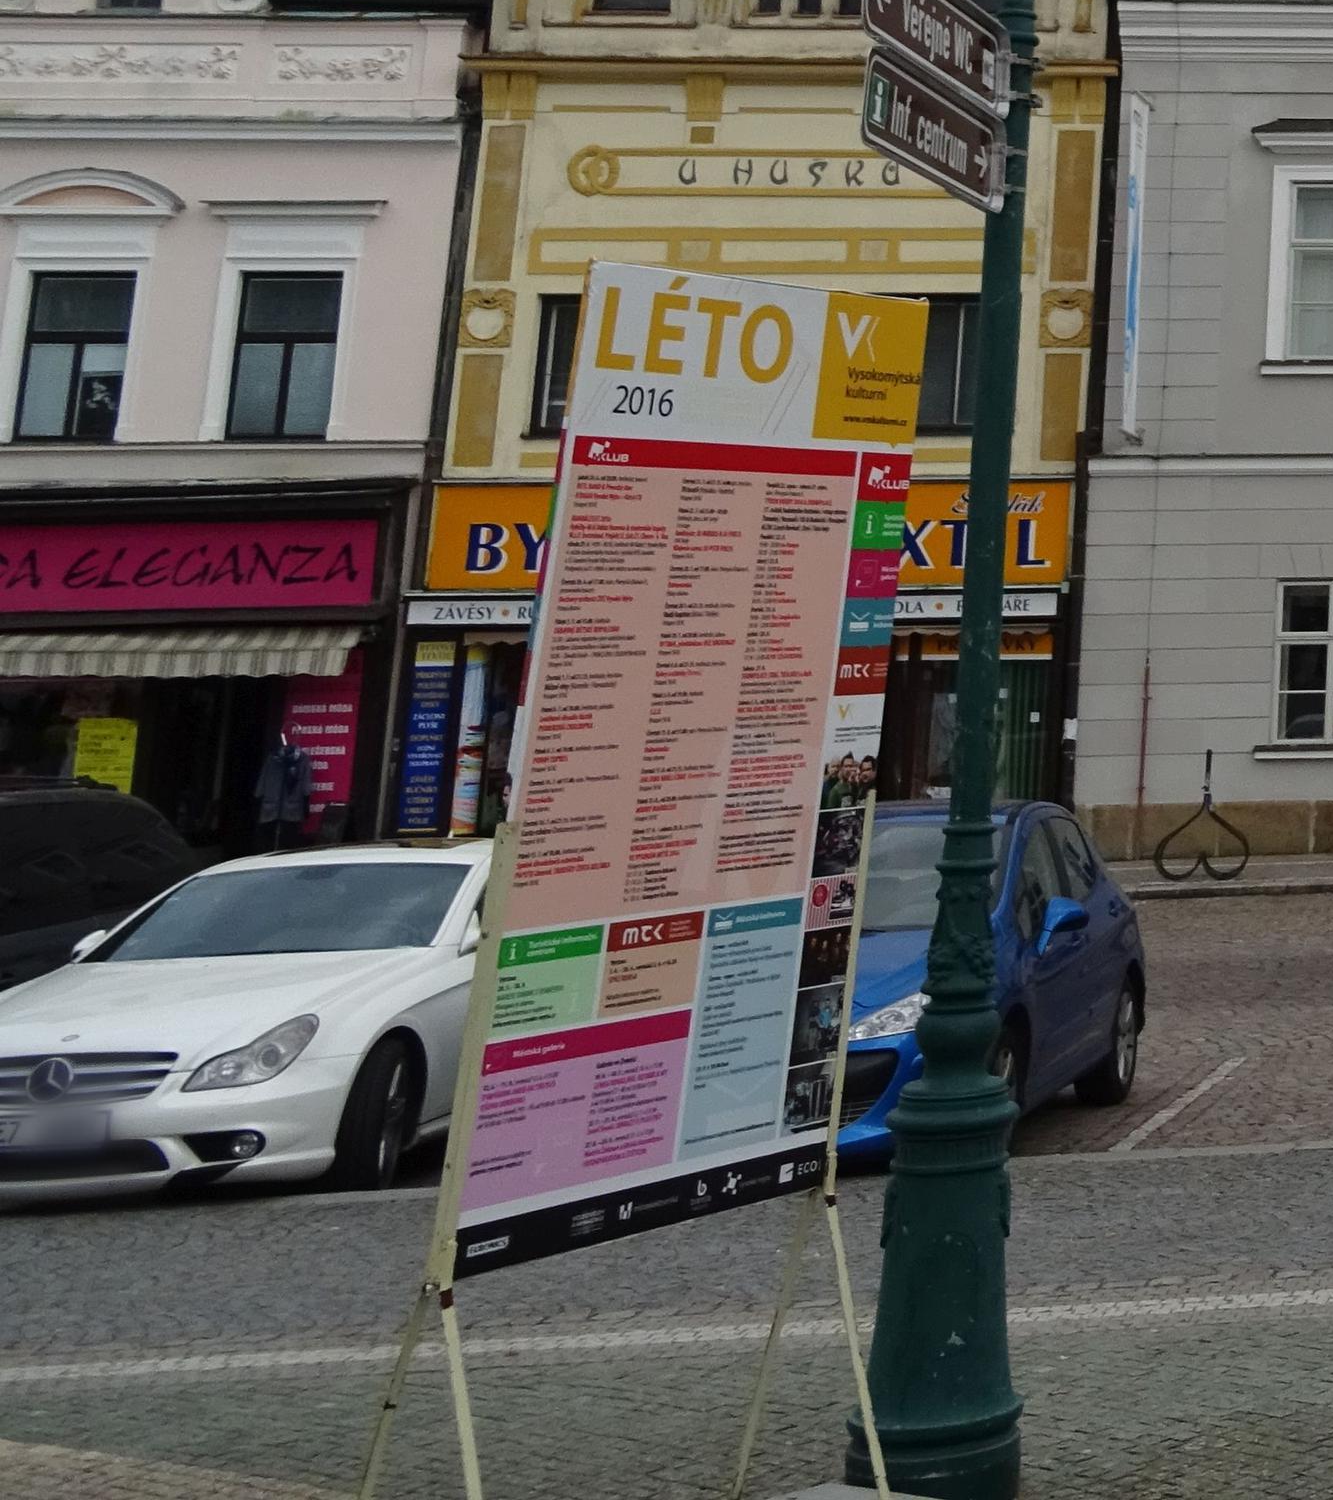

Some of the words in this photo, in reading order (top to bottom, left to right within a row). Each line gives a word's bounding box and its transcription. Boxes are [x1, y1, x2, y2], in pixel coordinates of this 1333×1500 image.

[954, 21, 973, 74] WC
[890, 86, 913, 144] Inf.
[916, 115, 969, 176] centrum
[595, 275, 794, 384] LÉTO
[612, 384, 675, 417] 2016
[61, 541, 361, 590] ELEGANZA
[434, 602, 496, 621] ZÁVĚSY
